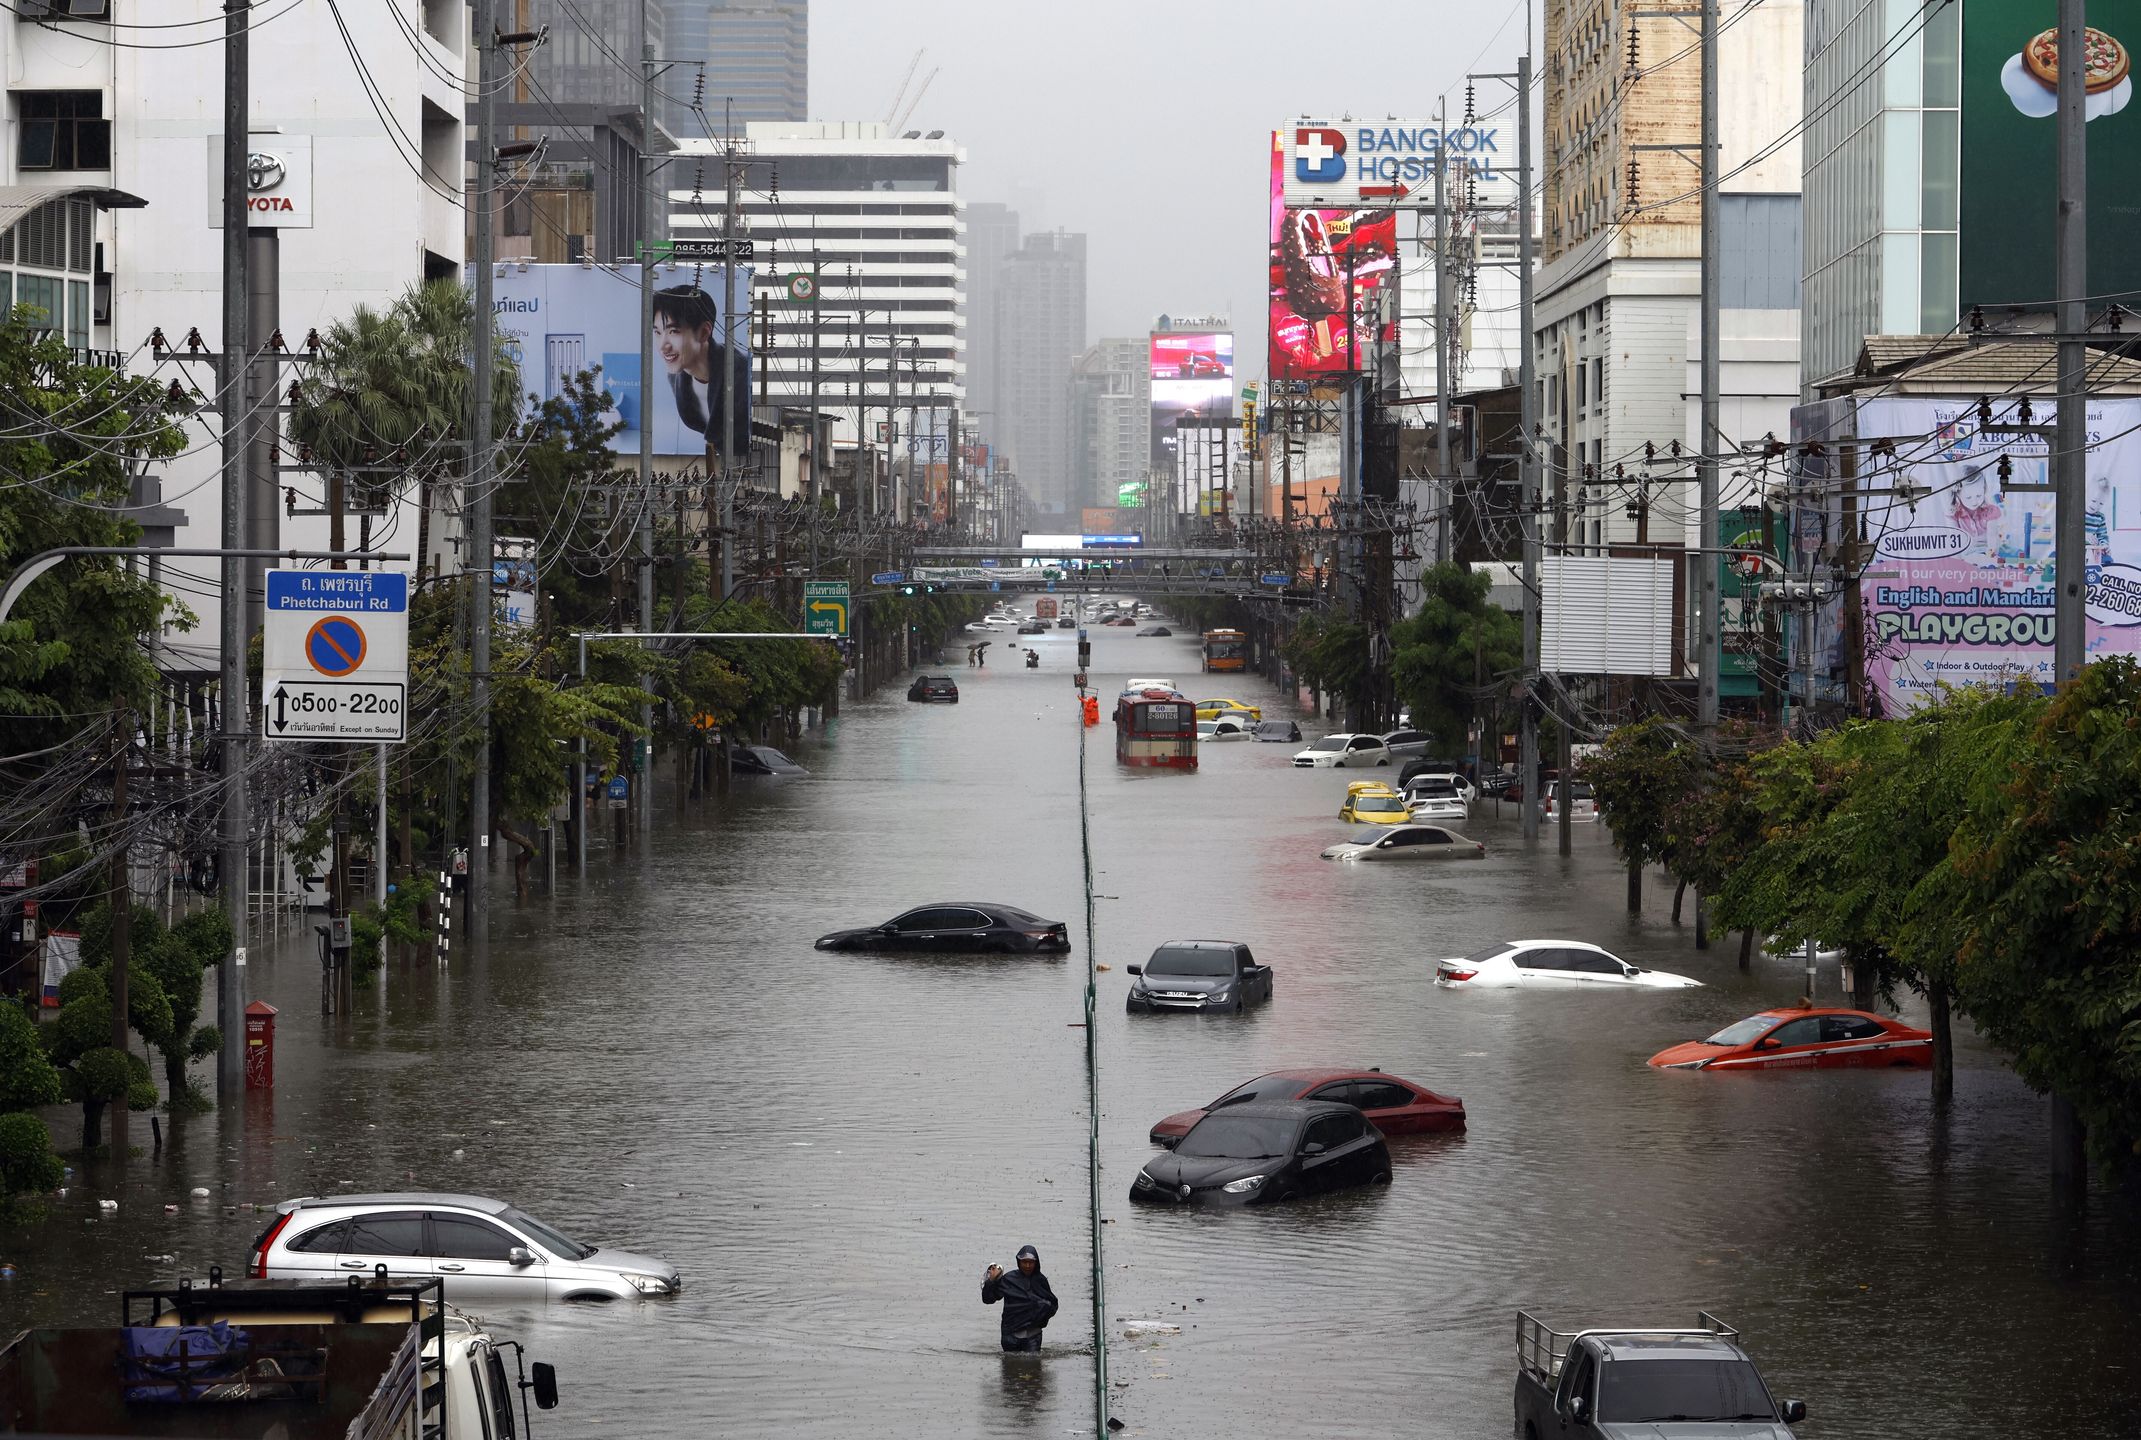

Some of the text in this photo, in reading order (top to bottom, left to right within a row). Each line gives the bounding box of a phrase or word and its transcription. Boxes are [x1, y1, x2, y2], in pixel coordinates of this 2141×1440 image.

[1358, 128, 1498, 152] BANGKOK
[247, 197, 293, 211] YOTA
[1174, 318, 1227, 327] ITALTHAI
[1884, 533, 1962, 551] SUKHUMVIT 31
[1911, 569, 1934, 579] our
[1938, 569, 1967, 583] very
[1969, 566, 2023, 583] popular
[2101, 573, 2126, 592] CALL
[301, 574, 373, 597] ถ. เพชรบุรี
[281, 596, 388, 610] Phetchaburi Rd
[1877, 585, 2055, 609] English and Mandari
[1876, 611, 2055, 646] PLAYGROU
[1936, 661, 2025, 672] Indoor & Outdoor Play
[339, 725, 362, 733] Except
[374, 726, 399, 735] Sunday
